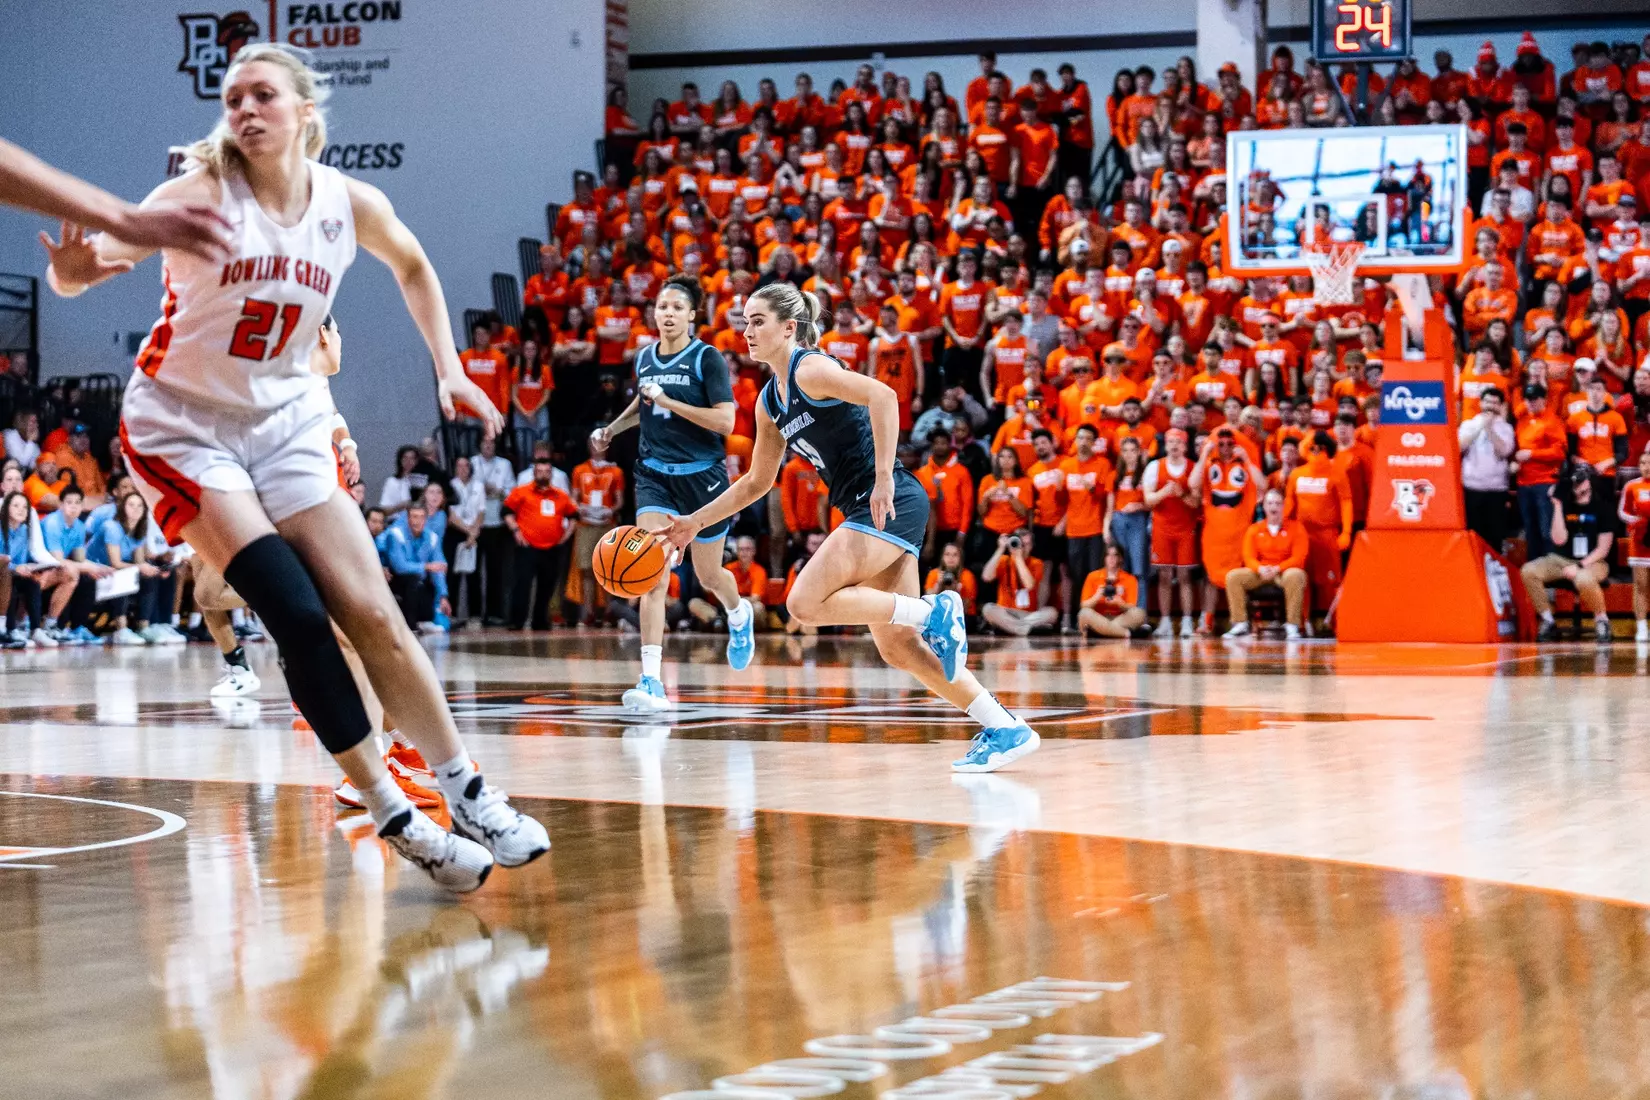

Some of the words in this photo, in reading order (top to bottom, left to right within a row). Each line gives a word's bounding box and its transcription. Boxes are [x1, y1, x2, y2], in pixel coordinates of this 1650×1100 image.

[289, 1, 401, 25] FALCON
[288, 26, 361, 47] CLUB
[1335, 5, 1392, 51] 24
[366, 56, 391, 69] and
[340, 72, 372, 85] Fund
[319, 142, 405, 170] CCESS
[228, 296, 303, 361] 21
[1384, 386, 1441, 420] Kroger
[1401, 432, 1426, 448] GO
[1387, 455, 1445, 467] FALCONS
